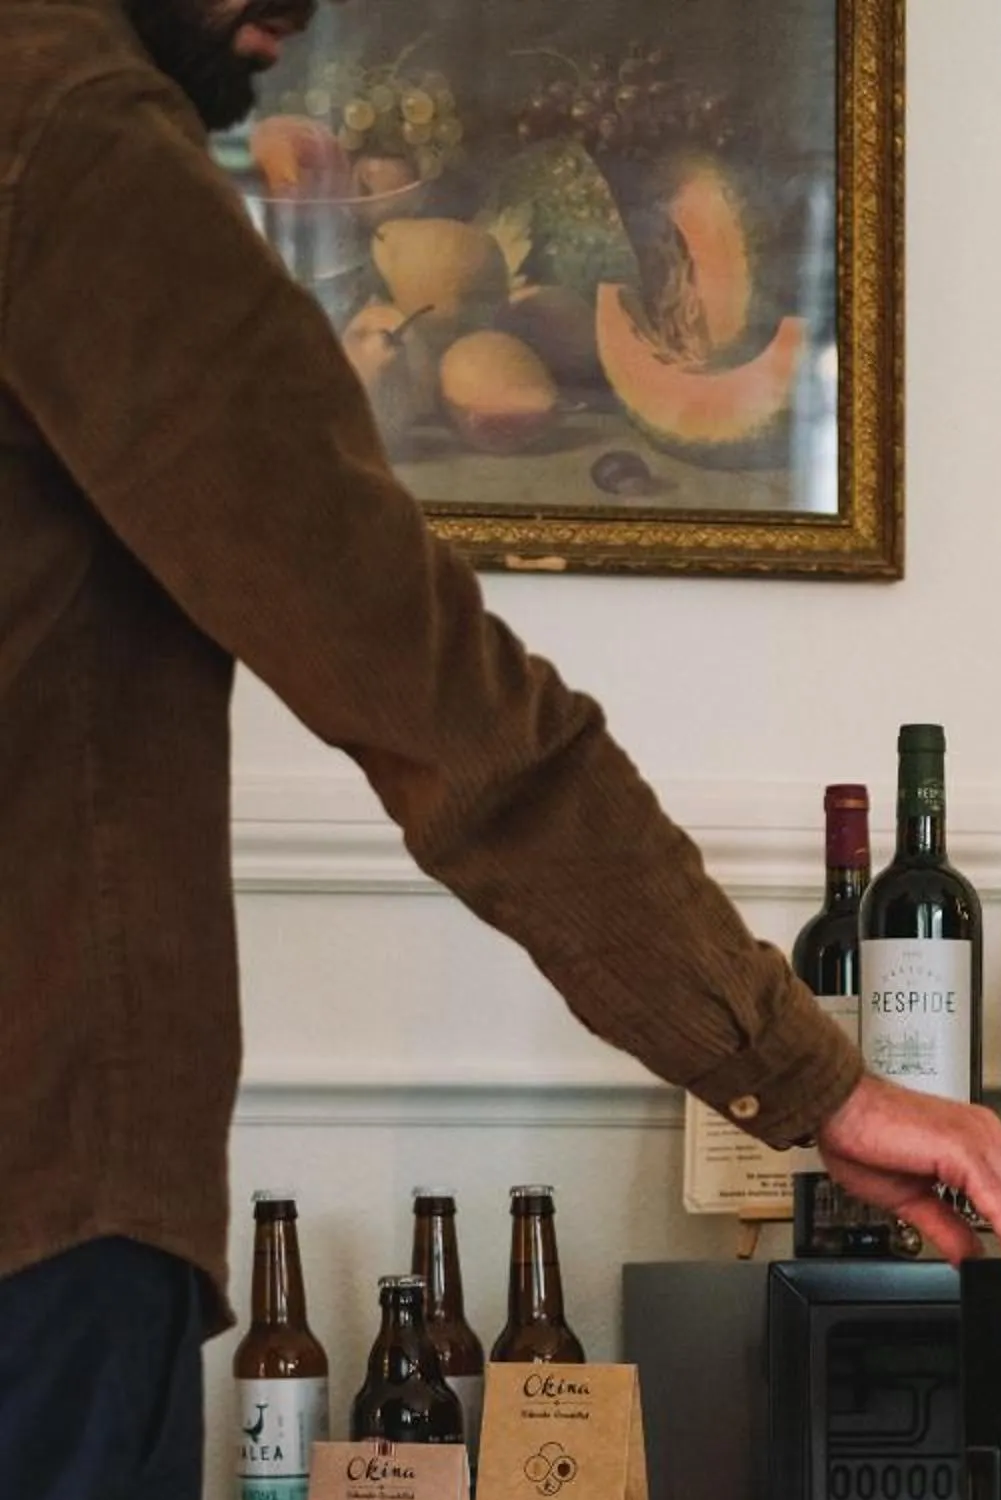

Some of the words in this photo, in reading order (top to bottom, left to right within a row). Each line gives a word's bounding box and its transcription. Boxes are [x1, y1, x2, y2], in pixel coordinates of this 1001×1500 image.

[871, 991, 956, 1013] RESPIDE
[523, 1373, 590, 1397] Okina
[346, 1456, 416, 1481] Okina
